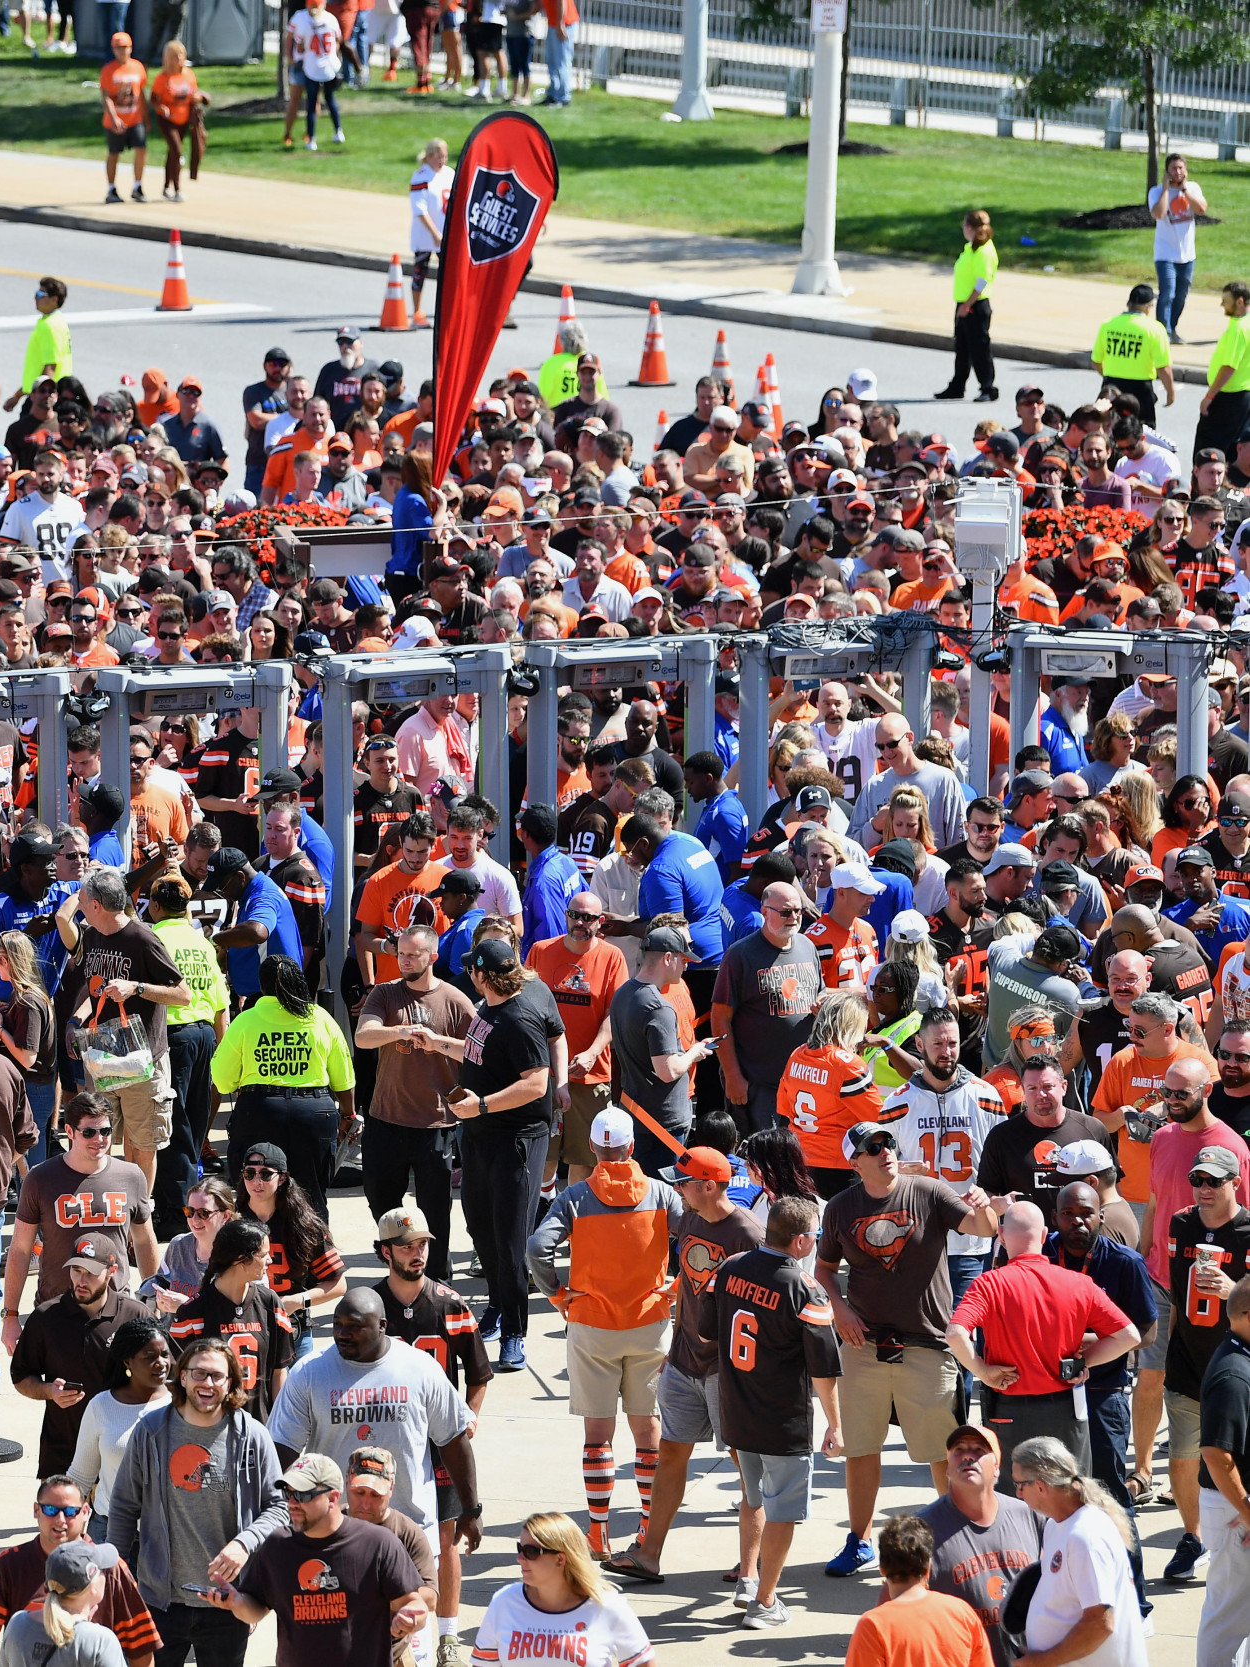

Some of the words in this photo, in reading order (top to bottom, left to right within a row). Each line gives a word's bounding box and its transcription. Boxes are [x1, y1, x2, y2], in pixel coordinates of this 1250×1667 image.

[484, 191, 518, 227] GUEST
[475, 203, 519, 244] SERVICES
[1106, 337, 1142, 361] STAFF
[1134, 655, 1145, 663] 31
[573, 831, 597, 854] 19
[173, 949, 209, 967] APEX
[992, 971, 1049, 1007] SUPERVISOR
[256, 1031, 308, 1048] APEX
[254, 1047, 313, 1065] SECURITY
[257, 1061, 309, 1078] GROUP
[789, 1061, 827, 1087] MAYFIELD
[1131, 1076, 1152, 1089] BAKER
[793, 1090, 819, 1133] 6
[917, 1115, 973, 1130] CLEVELAND
[918, 1131, 974, 1184] 13
[53, 1191, 128, 1229] CLE
[725, 1273, 782, 1311] MAYFIELD
[219, 1321, 262, 1334] CLEVELAND
[730, 1308, 760, 1373] 6
[227, 1333, 259, 1390] 6
[328, 1385, 409, 1407] CLEVELAND
[329, 1404, 409, 1426] BROWNS
[292, 1591, 347, 1607] CLEVELAND
[293, 1605, 348, 1622] BROWNS
[526, 1626, 574, 1635] CLEVELAND
[507, 1630, 589, 1667] BROWNS
